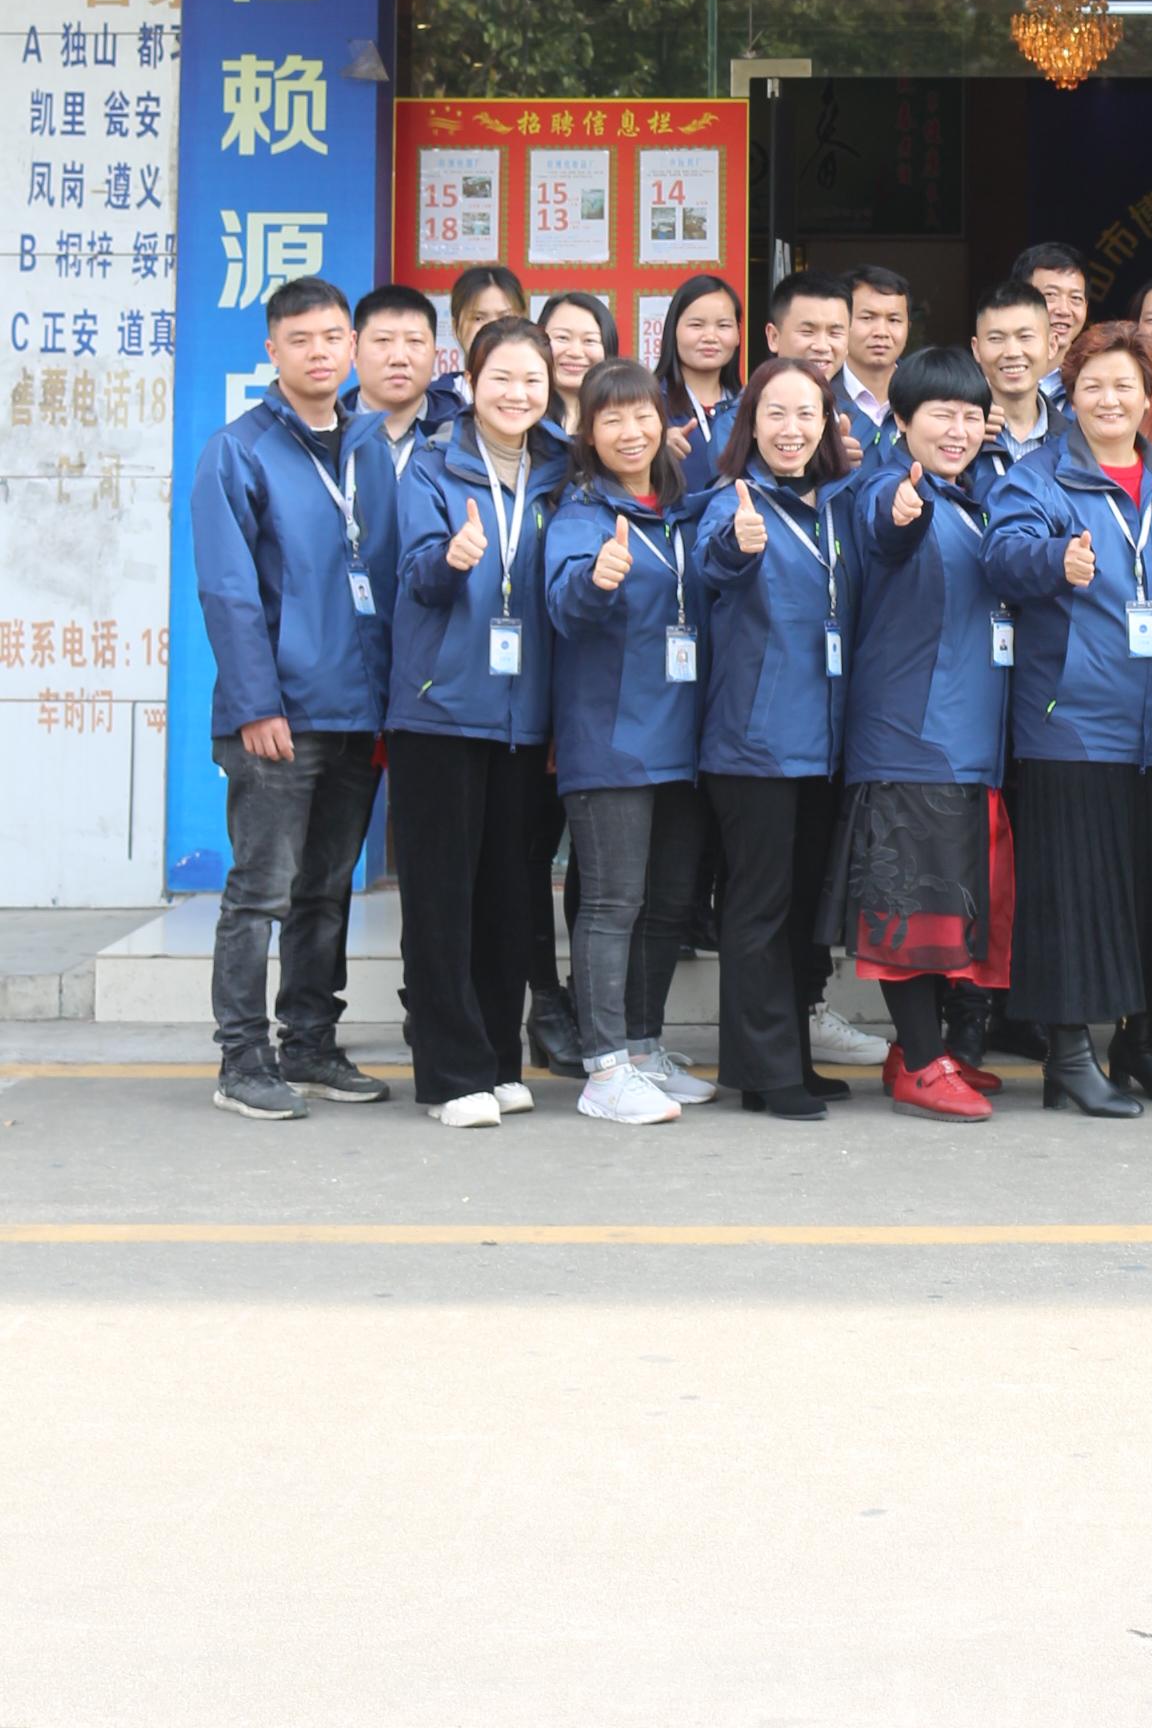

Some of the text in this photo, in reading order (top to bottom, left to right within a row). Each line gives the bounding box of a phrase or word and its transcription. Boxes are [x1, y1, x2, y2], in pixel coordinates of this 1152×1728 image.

[22, 25, 42, 63] A
[61, 21, 117, 67] 独山
[30, 88, 86, 137] 凯里
[516, 109, 674, 137] 招聘信息栏
[104, 161, 162, 210] 遵义
[425, 184, 458, 208] 15
[537, 182, 568, 205] 15
[651, 180, 685, 205] 14
[425, 217, 458, 241] 18
[537, 208, 569, 232] 13
[19, 233, 37, 272] B
[11, 309, 175, 357] C 正安 道真
